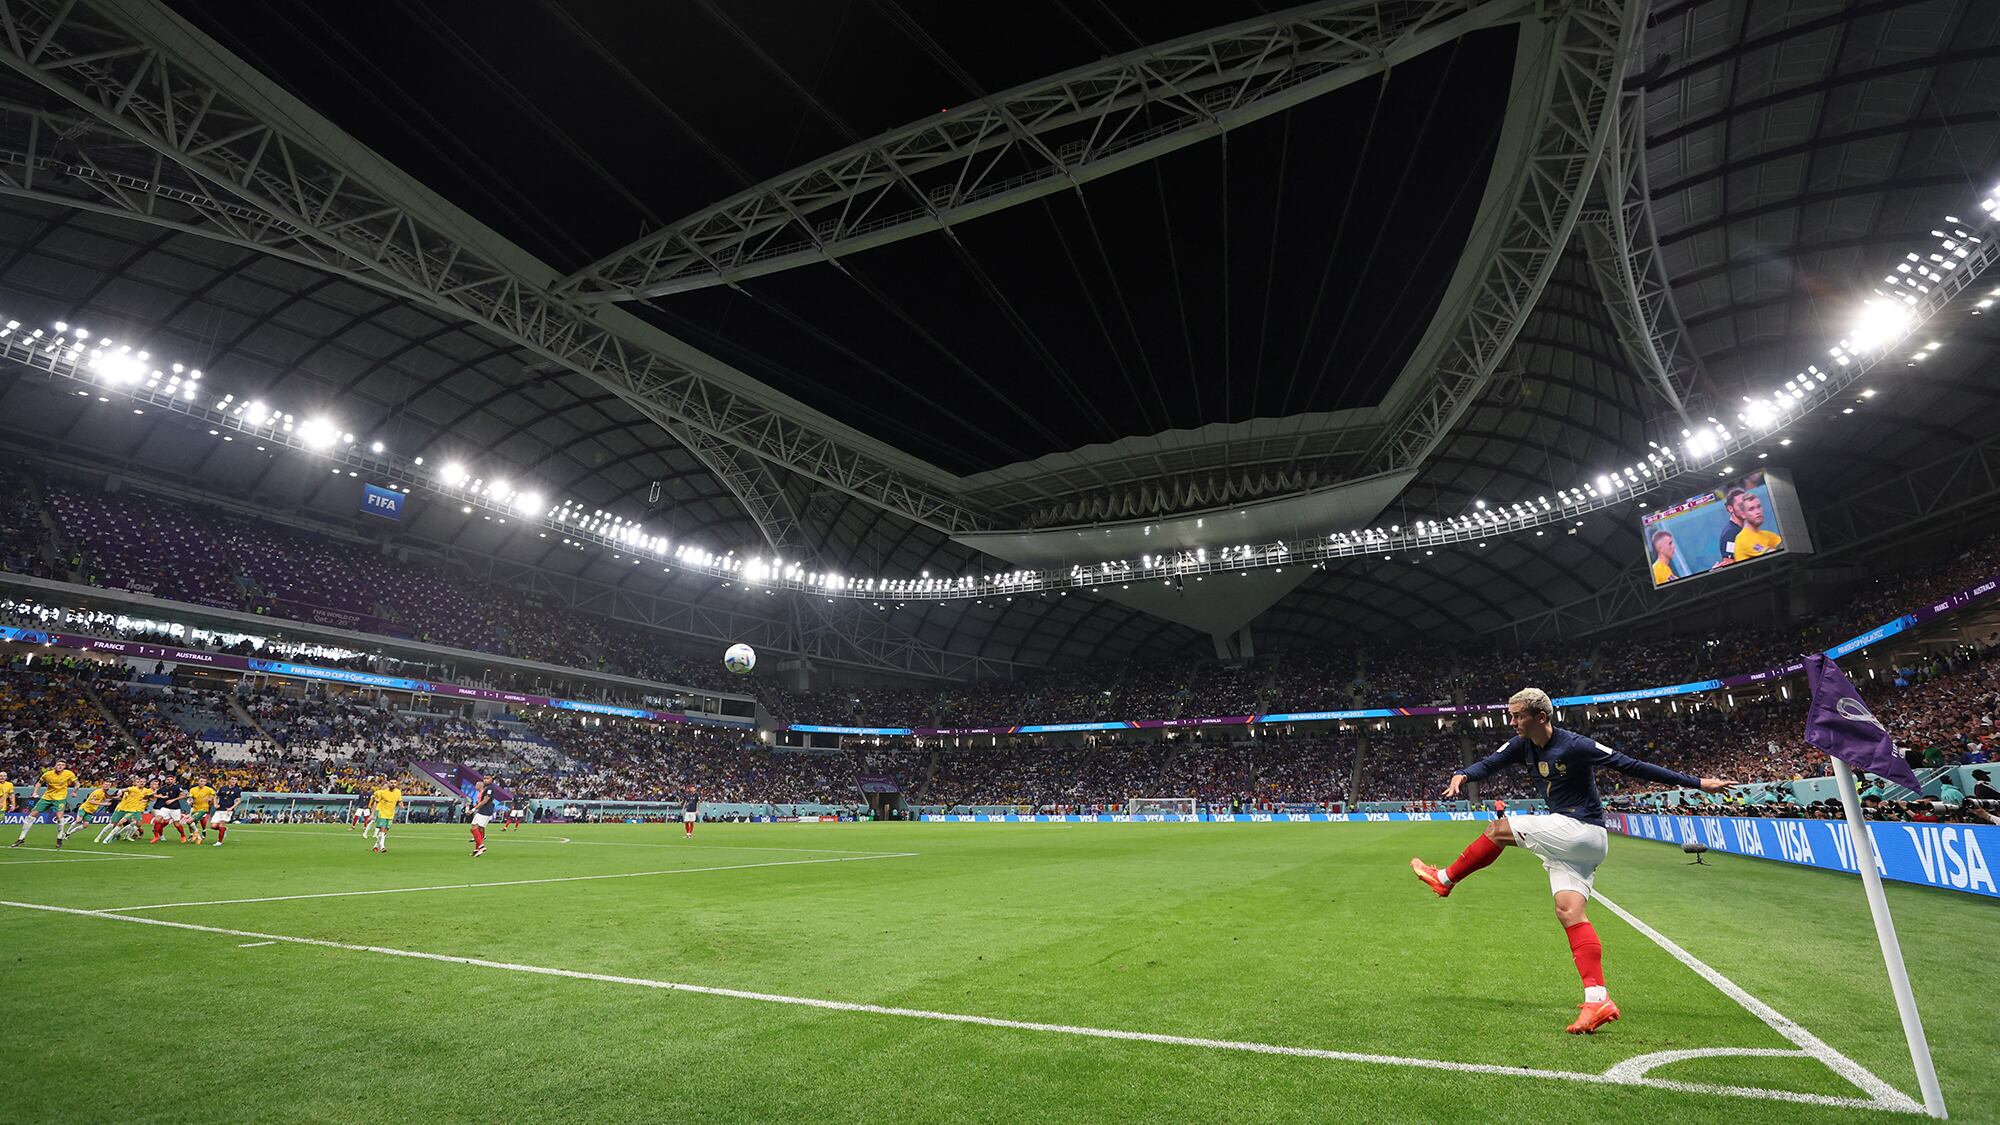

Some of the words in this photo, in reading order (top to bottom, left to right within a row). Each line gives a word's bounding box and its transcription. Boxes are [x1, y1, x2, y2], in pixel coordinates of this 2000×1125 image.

[368, 494, 396, 511] FIFA
[1934, 602, 1949, 613] FRANCE
[1973, 581, 1996, 596] AUSTRALIA
[94, 641, 125, 651] FRANCE
[176, 651, 212, 662] AUSTRALIA
[291, 666, 306, 674] FIFA
[306, 668, 331, 677] WORLD
[331, 671, 344, 679] CUP
[1213, 814, 1235, 822] VISA
[1250, 814, 1272, 822] VISA
[1287, 814, 1311, 822] VISA
[1325, 813, 1349, 822] VISA
[1364, 813, 1390, 822] VISA
[1406, 812, 1432, 821] VISA
[1447, 812, 1475, 821] VISA
[1656, 816, 1675, 842] VISA
[1676, 817, 1699, 845] VISA
[1701, 818, 1727, 850] VISA
[1731, 819, 1765, 856] VISA
[1771, 820, 1815, 864] VISA
[1825, 823, 1887, 876] VIA
[1903, 826, 1998, 893] VISA
